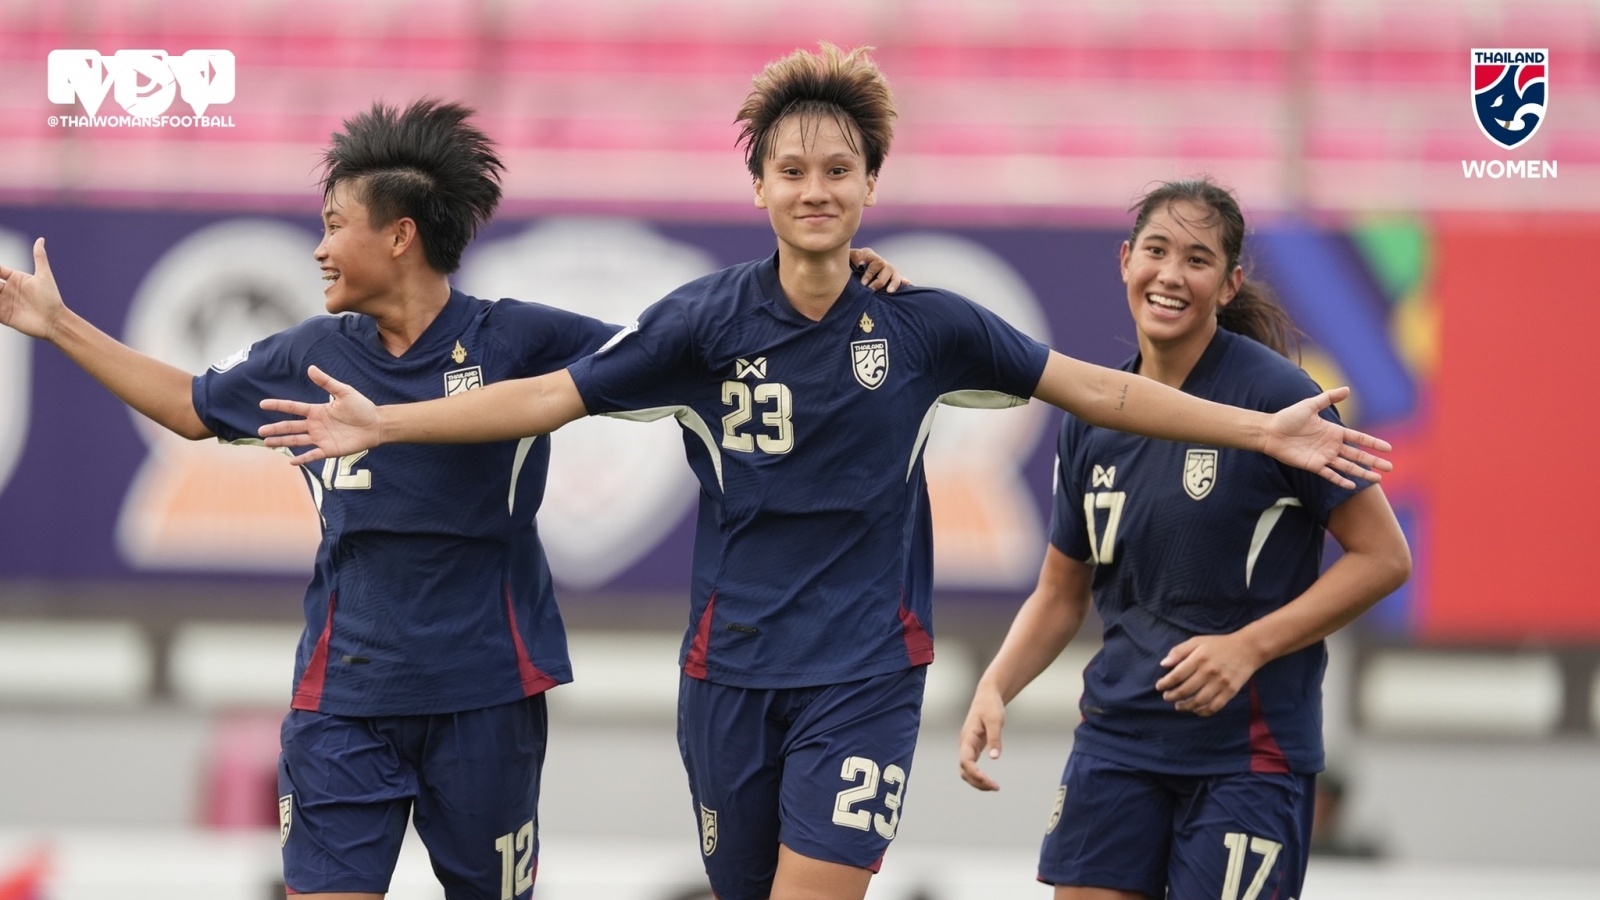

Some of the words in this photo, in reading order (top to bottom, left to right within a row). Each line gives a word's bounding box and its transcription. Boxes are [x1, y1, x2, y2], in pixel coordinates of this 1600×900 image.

[447, 370, 478, 381] THAILAND
[854, 343, 885, 352] THAILAND
[721, 380, 795, 455] 23
[1083, 491, 1127, 565] 17
[832, 756, 906, 840] 23
[495, 820, 534, 900] 12
[1221, 833, 1283, 900] 17
